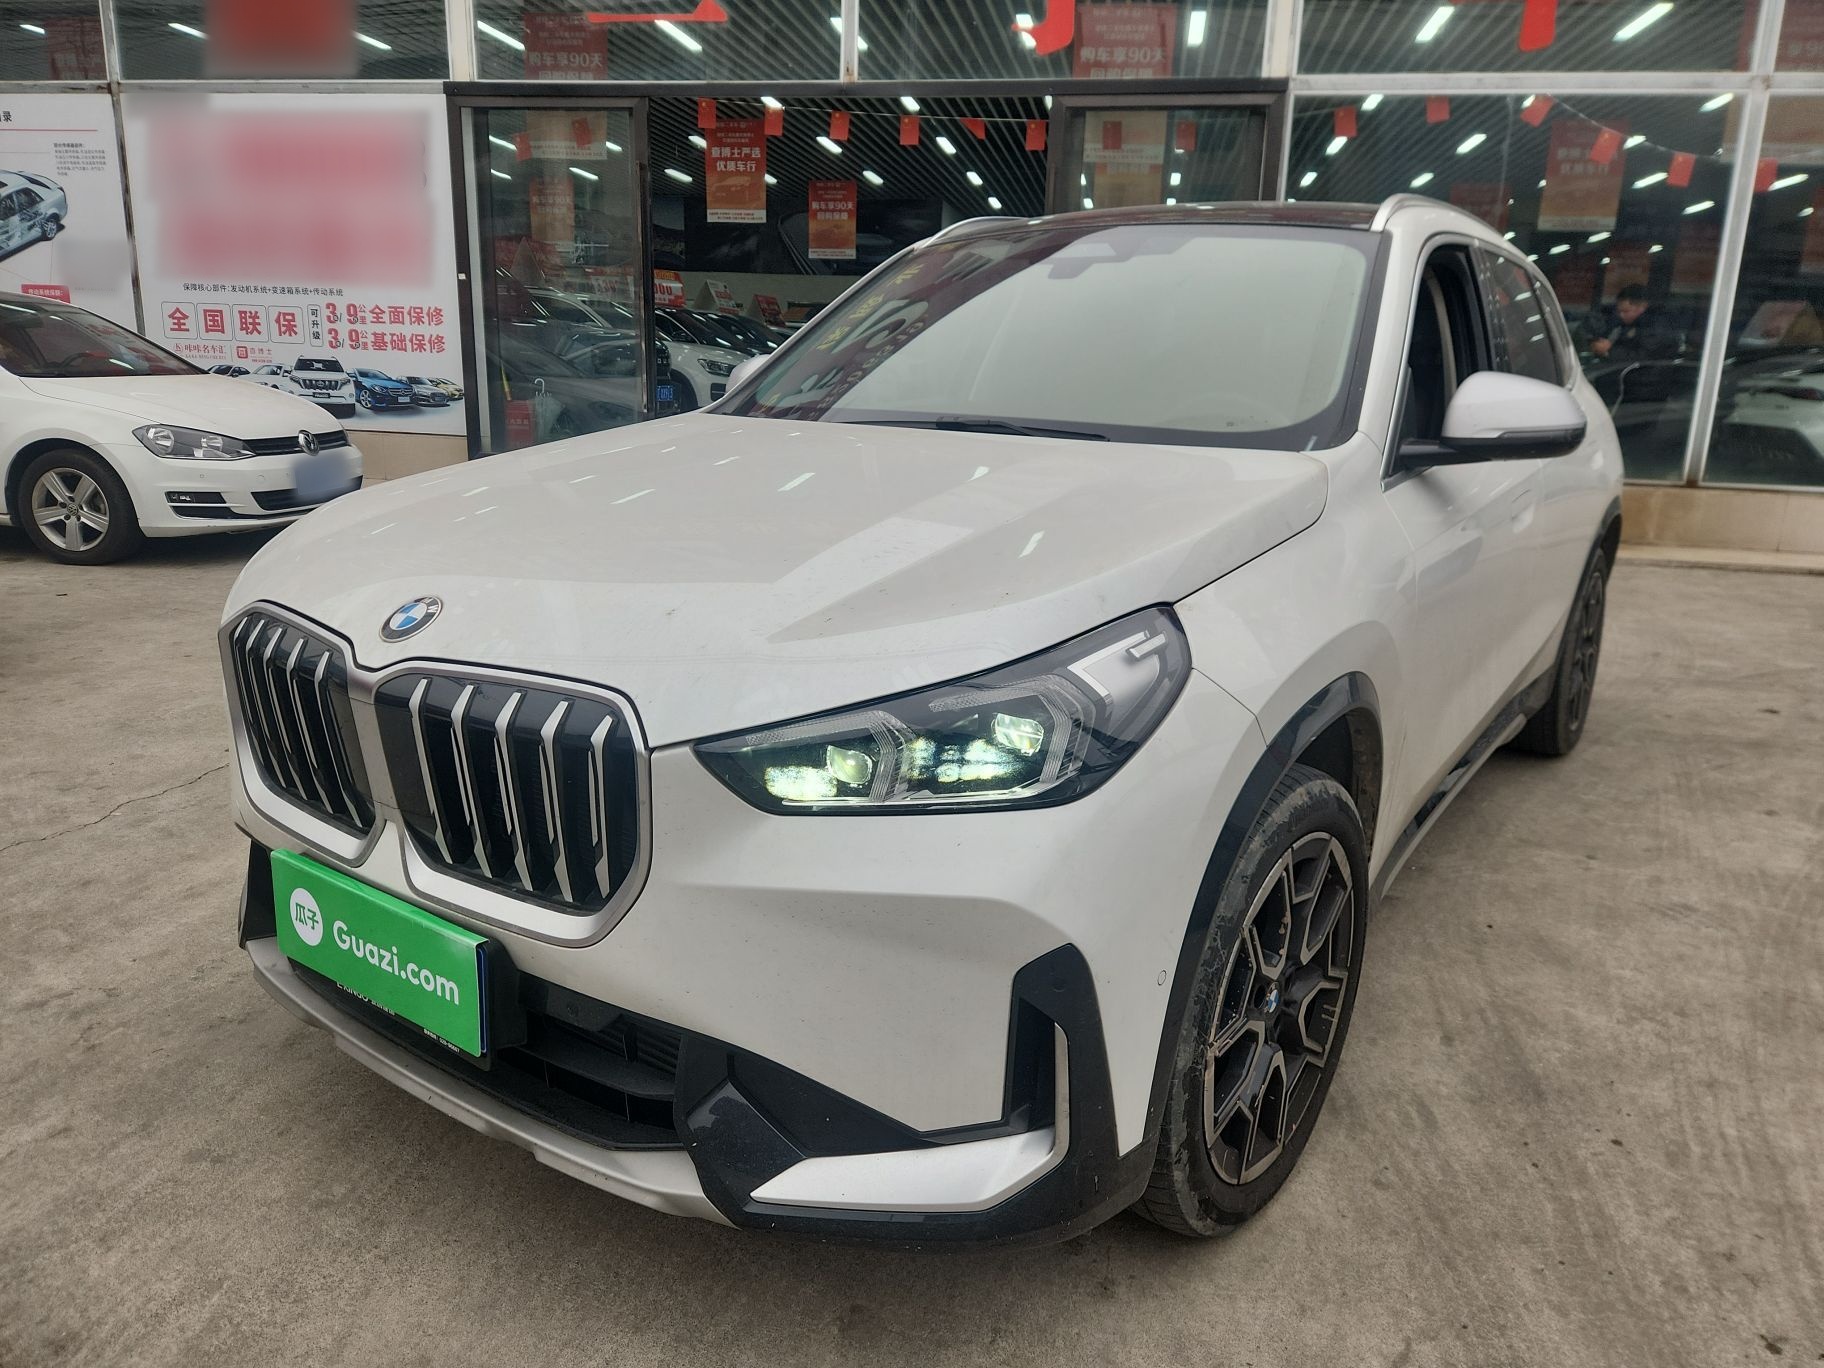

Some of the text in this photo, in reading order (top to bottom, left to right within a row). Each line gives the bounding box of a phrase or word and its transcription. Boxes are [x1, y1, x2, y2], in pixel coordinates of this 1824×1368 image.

[711, 146, 761, 158] 查博士严选
[716, 160, 757, 172] 优质车行
[167, 307, 298, 337] 全国联保
[310, 308, 321, 340] 可升级
[295, 903, 319, 930] 瓜子
[333, 920, 459, 1005] Guazi.com
